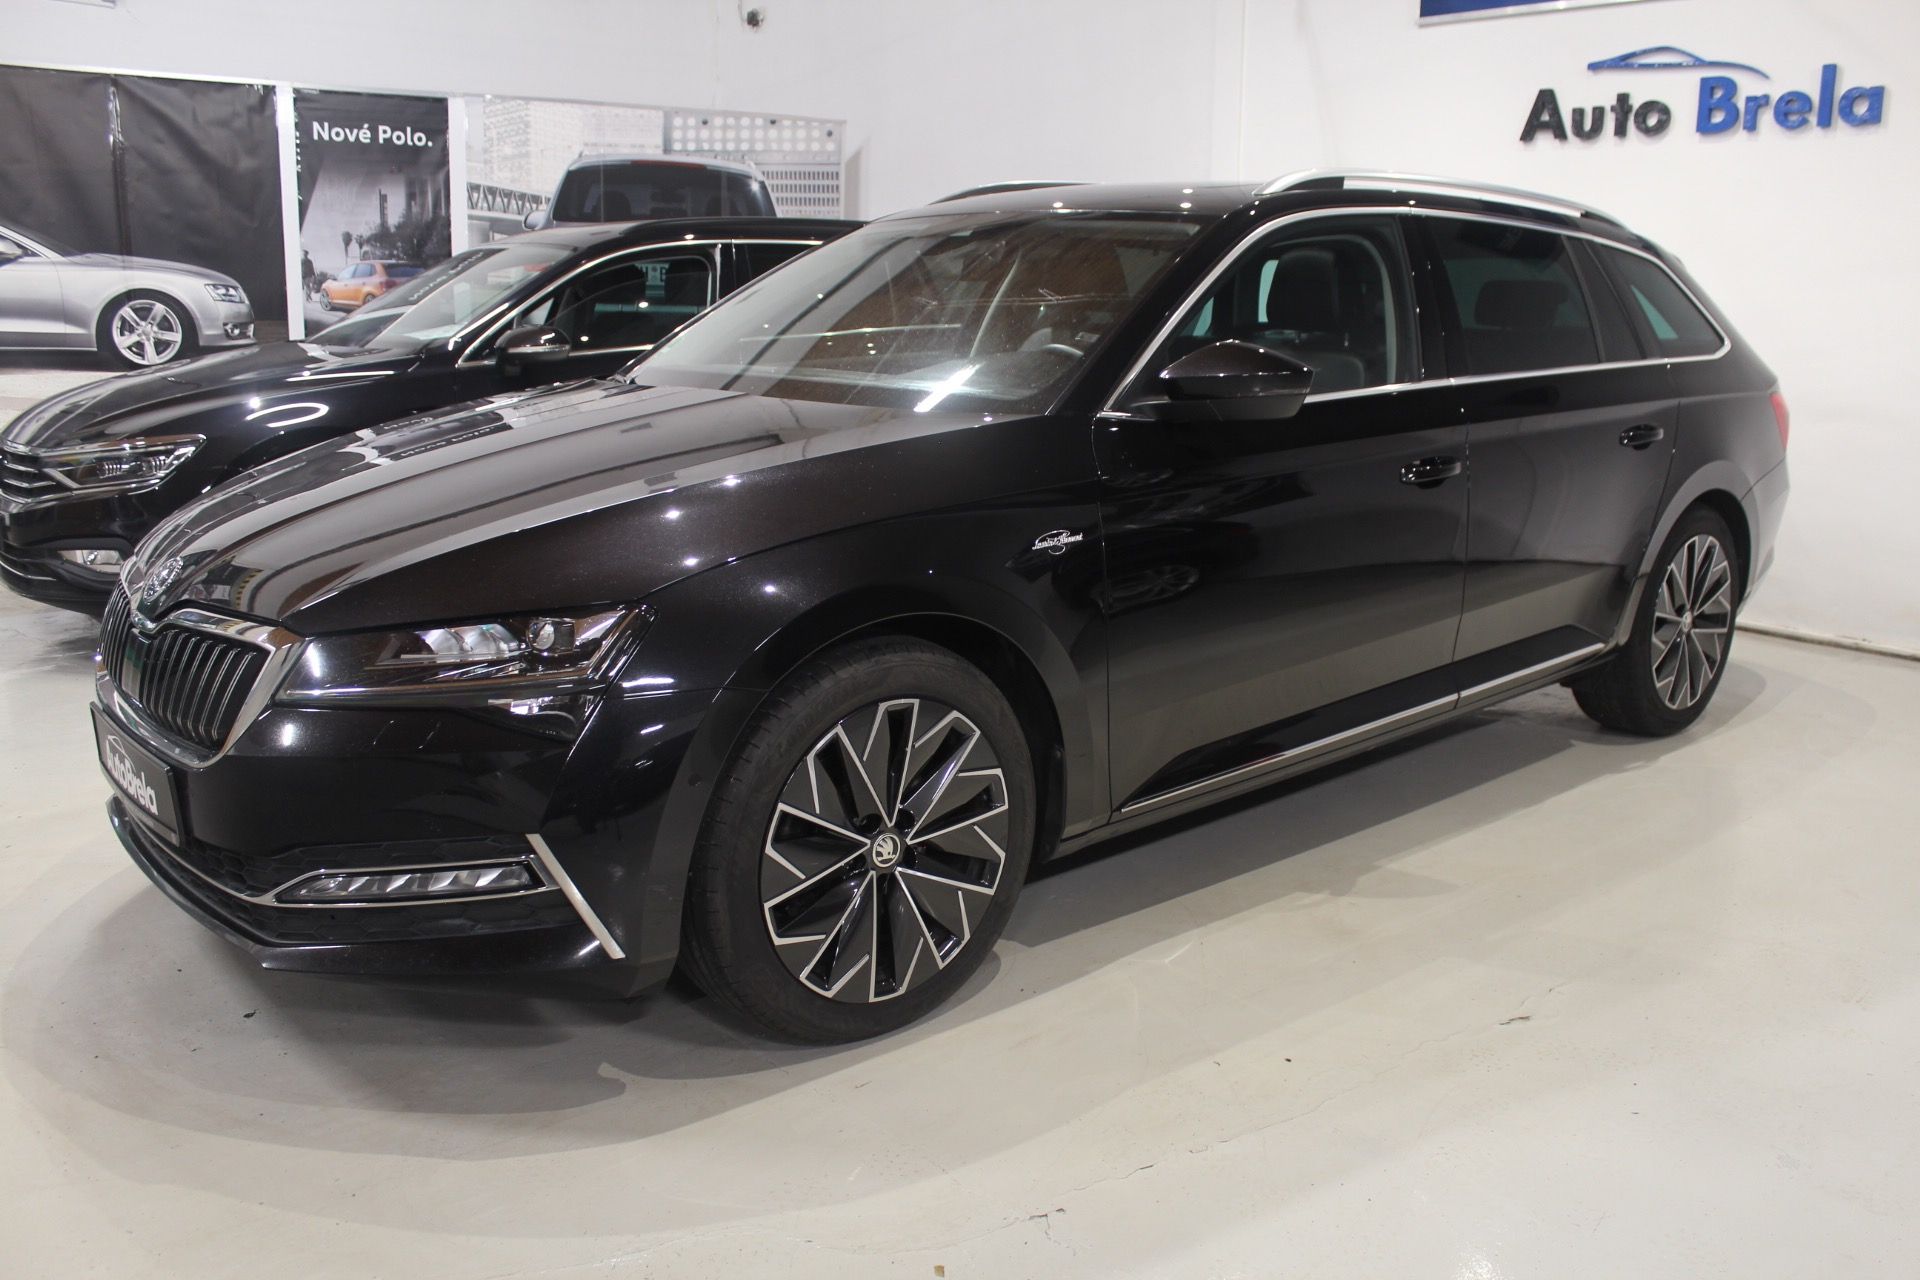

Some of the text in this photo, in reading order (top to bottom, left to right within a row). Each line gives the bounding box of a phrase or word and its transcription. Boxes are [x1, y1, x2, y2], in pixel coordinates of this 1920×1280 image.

[1519, 64, 1885, 142] Auto Brela
[312, 121, 433, 147] Nové Polo.
